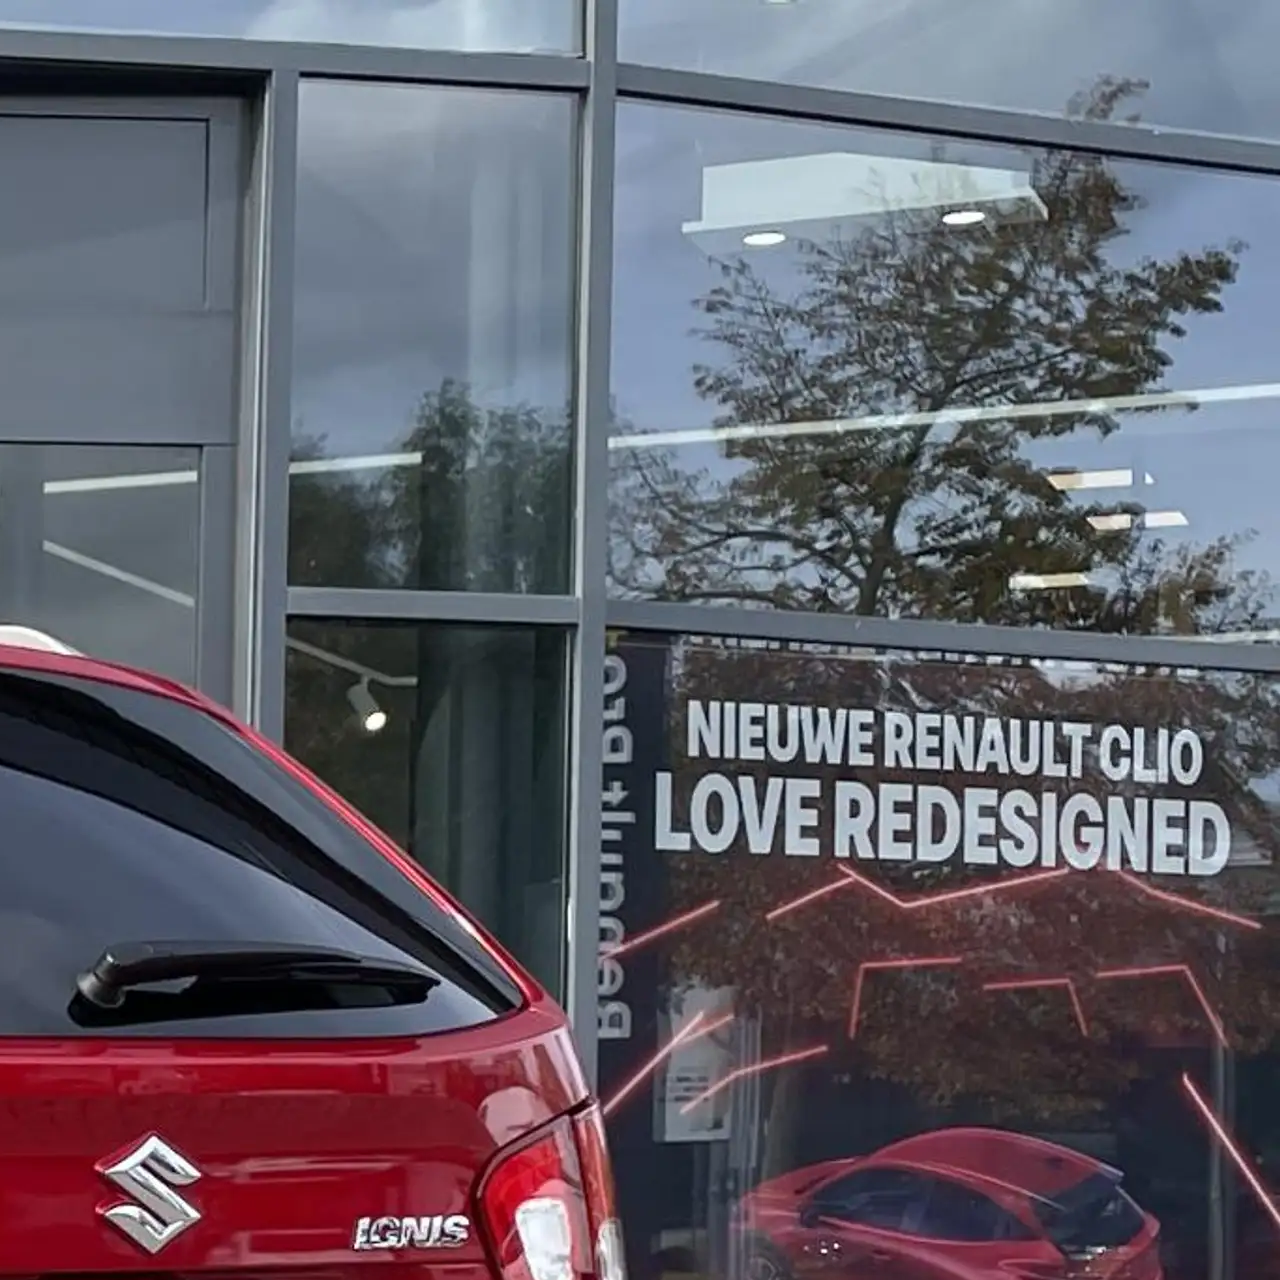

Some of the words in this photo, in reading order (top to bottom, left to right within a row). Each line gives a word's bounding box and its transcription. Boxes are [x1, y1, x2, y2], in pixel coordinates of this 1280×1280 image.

[687, 700, 874, 766] NIEUWE
[884, 711, 1092, 778] RENAULT
[1099, 724, 1203, 785] CLIO
[655, 771, 820, 856] LOVE
[834, 780, 1231, 876] REDESIGNED
[354, 1214, 470, 1250] IGNIS
